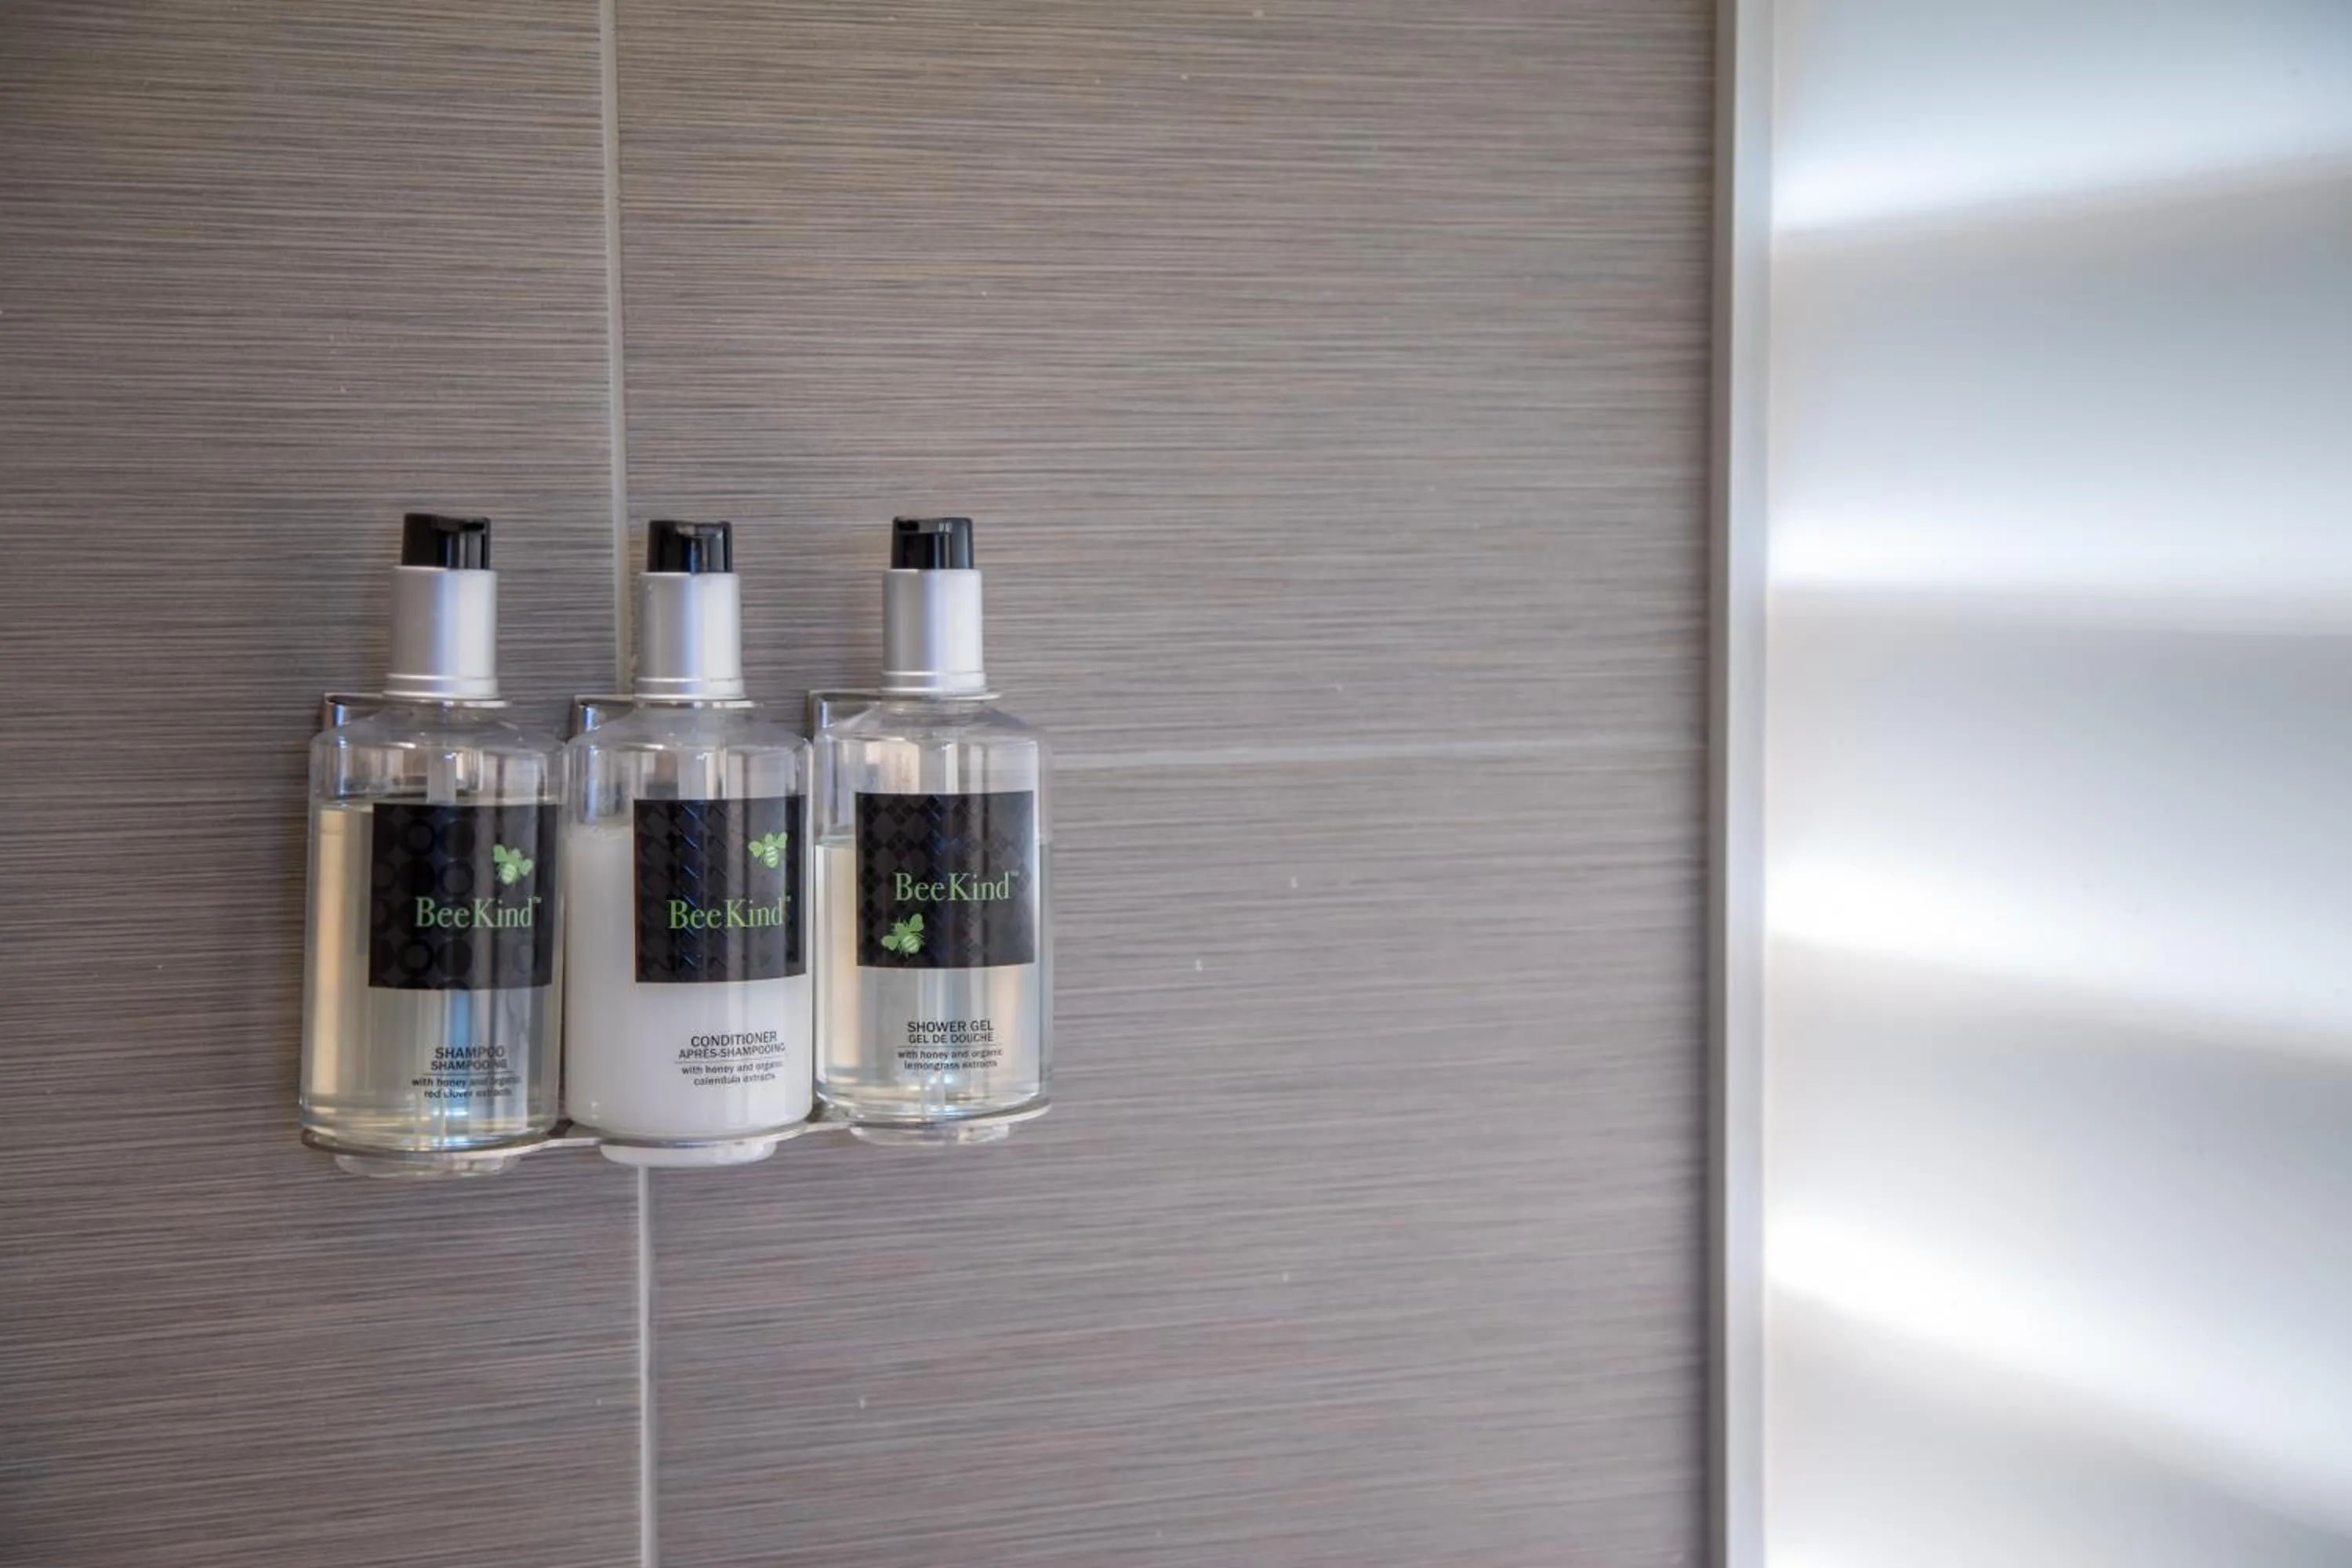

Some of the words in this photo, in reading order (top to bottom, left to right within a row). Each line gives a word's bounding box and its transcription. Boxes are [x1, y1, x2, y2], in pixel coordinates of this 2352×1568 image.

[907, 1021, 967, 1033] SHOWER
[970, 1019, 994, 1031] GEL
[691, 1031, 777, 1047] CONDITIONER
[909, 1033, 929, 1044] GEL
[932, 1033, 948, 1044] DE
[950, 1032, 993, 1043] DOUCHE
[435, 1046, 504, 1058] SHAMPOO
[897, 1051, 918, 1059] with
[920, 1051, 949, 1061] honey
[951, 1050, 969, 1058] and
[971, 1049, 1003, 1059] organic
[681, 1065, 703, 1075] with
[705, 1064, 734, 1074] honey
[736, 1062, 753, 1072] and
[412, 1078, 434, 1087] with
[437, 1078, 466, 1087] honey
[424, 1089, 441, 1098] red
